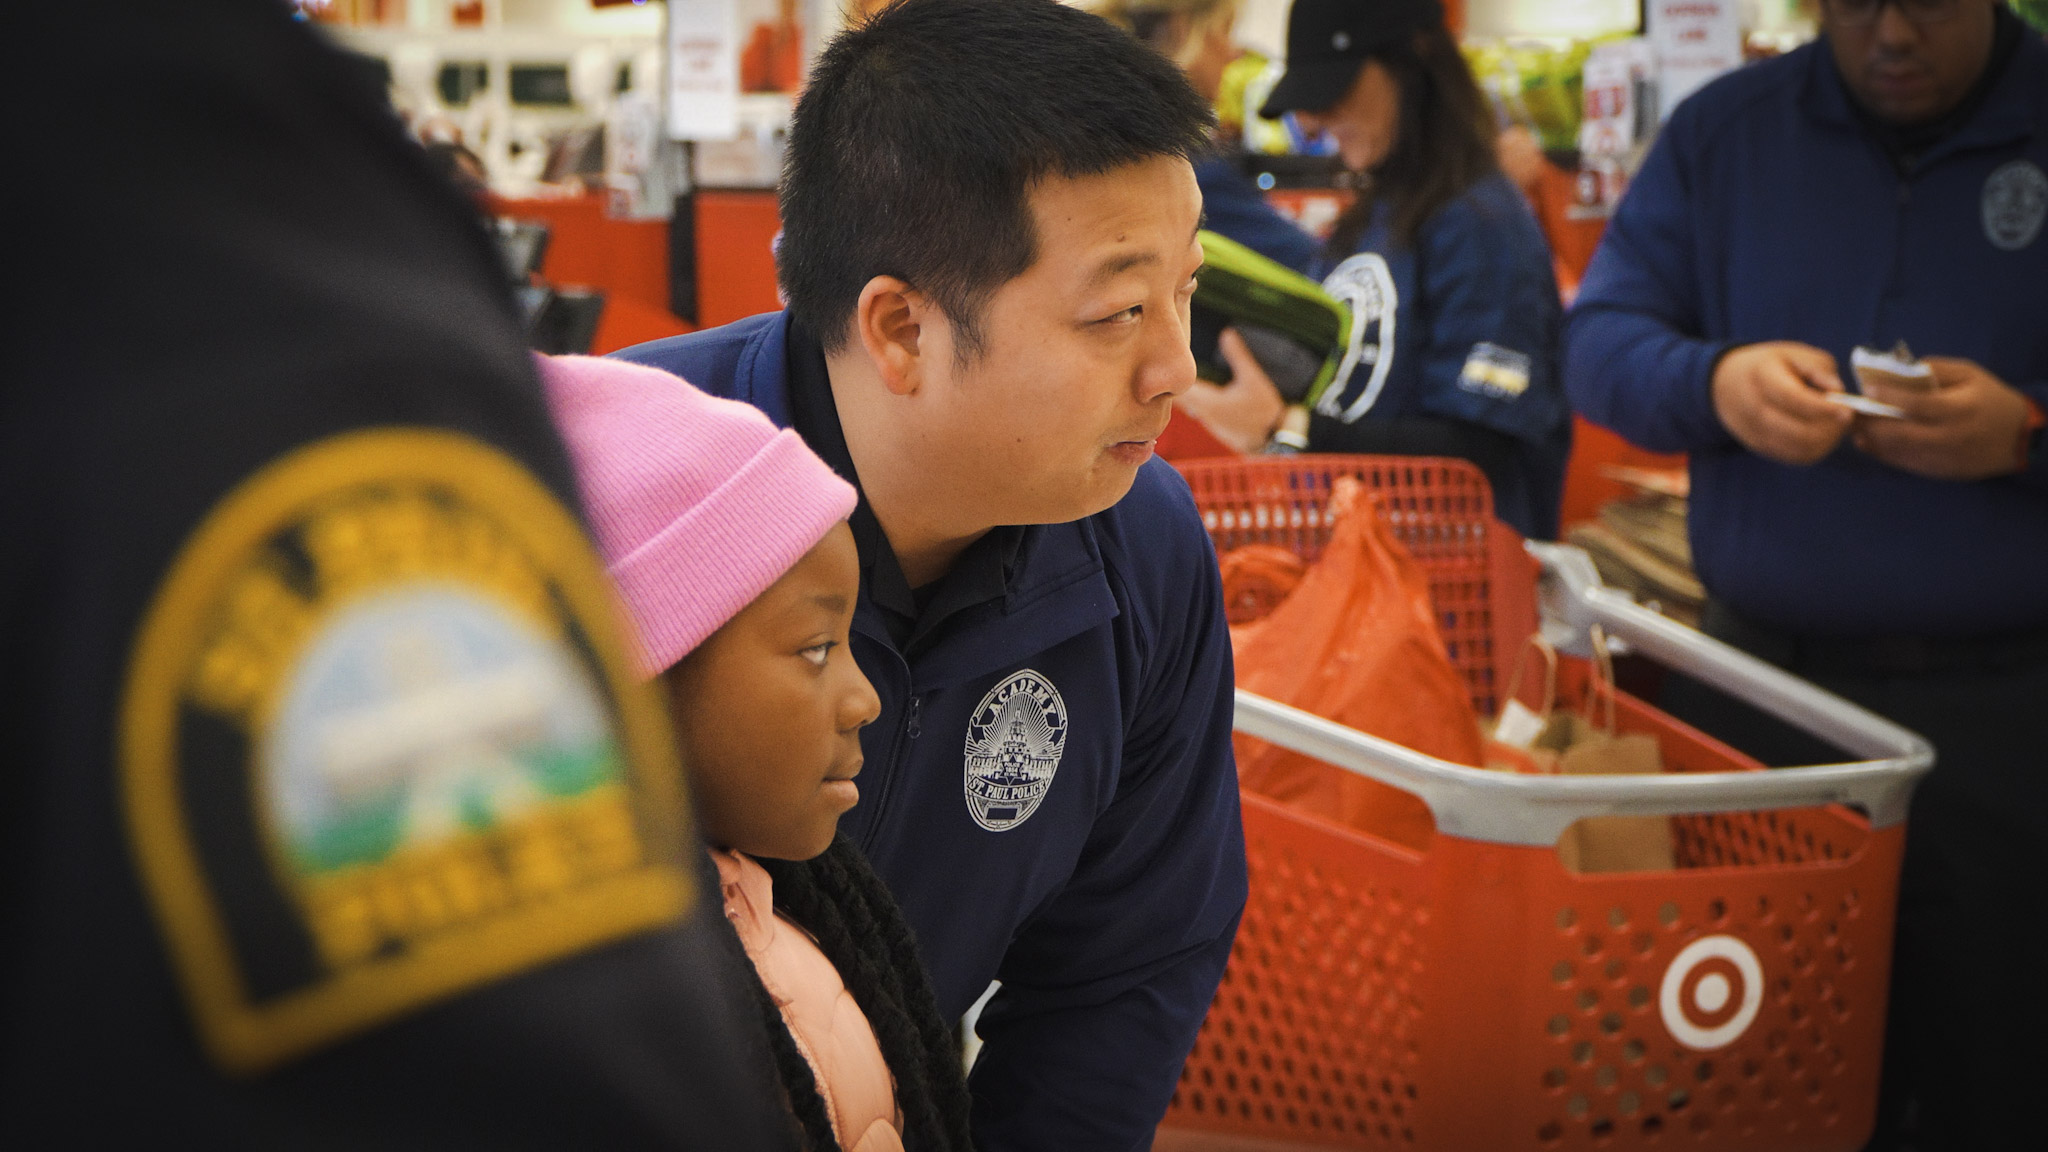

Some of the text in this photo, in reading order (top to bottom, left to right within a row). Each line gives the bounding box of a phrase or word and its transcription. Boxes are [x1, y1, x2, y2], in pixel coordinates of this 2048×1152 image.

[988, 679, 1056, 716] ACADEMY
[969, 778, 1046, 800] ST. PAUL POLICE
